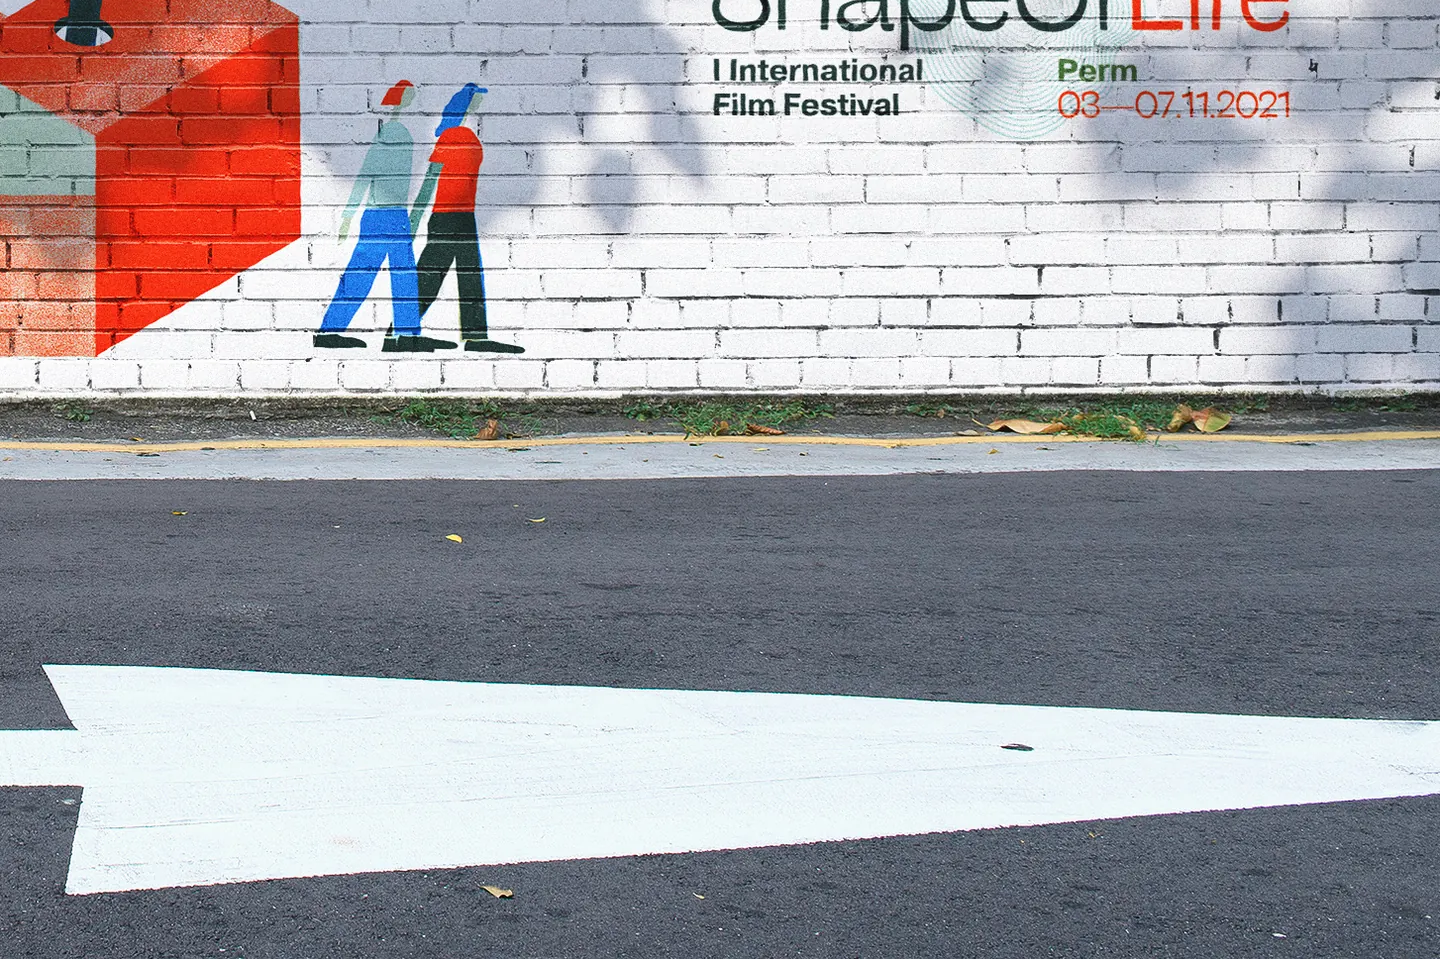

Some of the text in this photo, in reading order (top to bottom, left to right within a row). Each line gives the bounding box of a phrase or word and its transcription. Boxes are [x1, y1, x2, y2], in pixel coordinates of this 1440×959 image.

[730, 58, 923, 81] International
[1058, 58, 1138, 82] Perm
[713, 92, 899, 116] Film Festival
